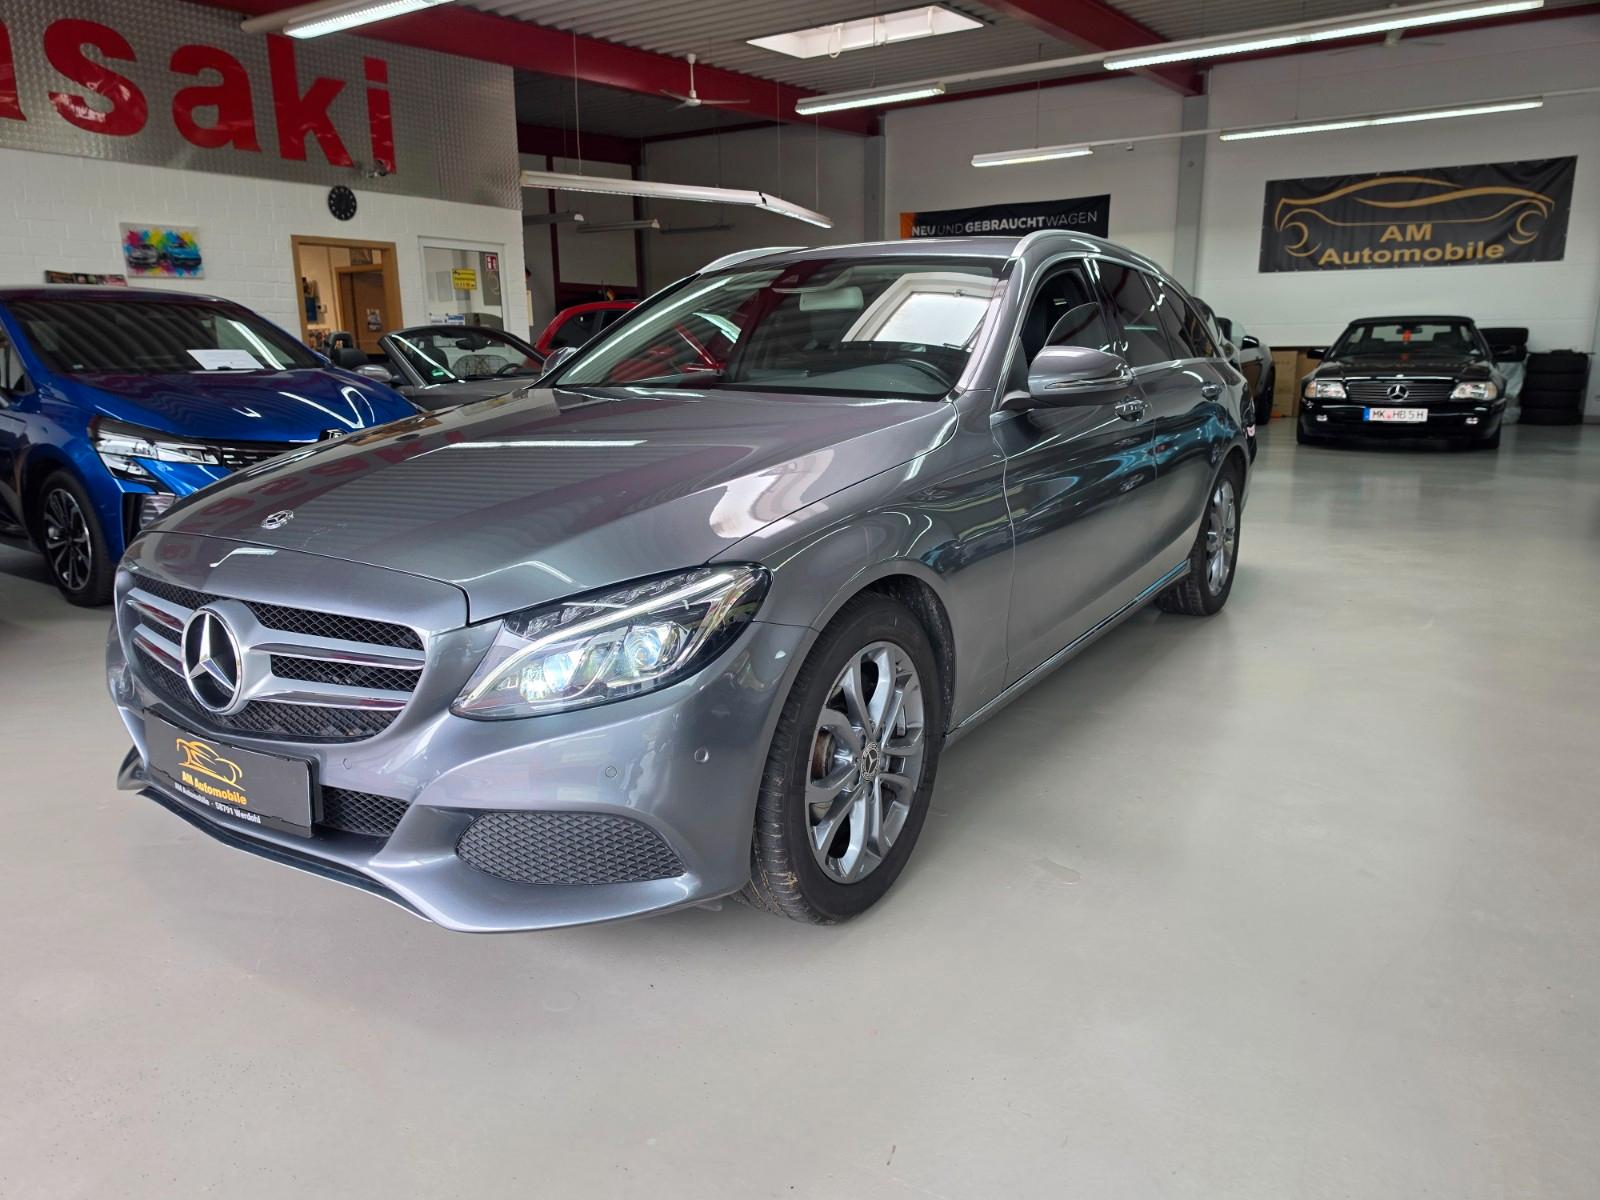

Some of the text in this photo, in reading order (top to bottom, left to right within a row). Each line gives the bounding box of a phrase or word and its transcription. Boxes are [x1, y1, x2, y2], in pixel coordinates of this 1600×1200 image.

[0, 18, 396, 174] saki
[1379, 223, 1433, 243] AM
[1318, 241, 1505, 265] Automobile
[194, 778, 247, 805] Automobile
